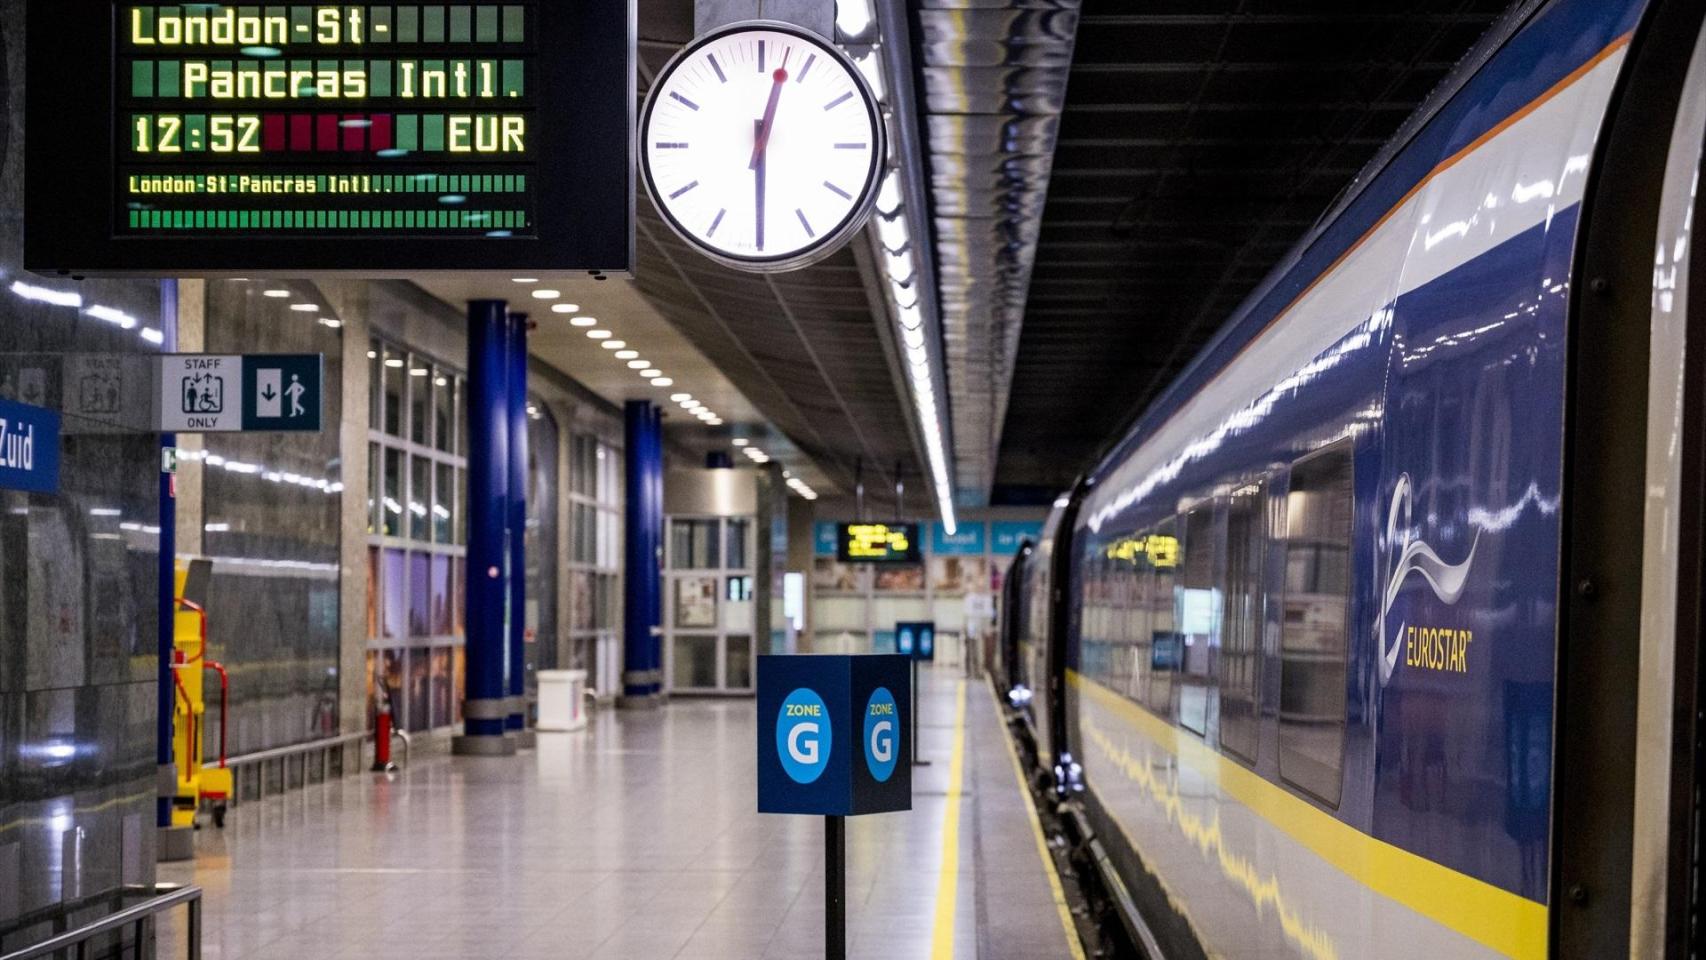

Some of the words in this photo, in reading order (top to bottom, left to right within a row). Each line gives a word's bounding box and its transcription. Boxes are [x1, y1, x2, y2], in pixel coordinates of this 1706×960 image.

[131, 8, 389, 45] London-St-
[184, 62, 366, 99] Pancras
[401, 62, 518, 98] Intl.
[136, 116, 261, 152] 12:52
[449, 116, 525, 152] EUR
[129, 175, 317, 193] London-St-Pancras
[184, 358, 222, 370] STAFF
[187, 417, 218, 429] ONLY
[785, 704, 822, 717] ZONE
[869, 703, 894, 716] ZONE
[787, 722, 820, 765] G
[870, 720, 893, 763] G
